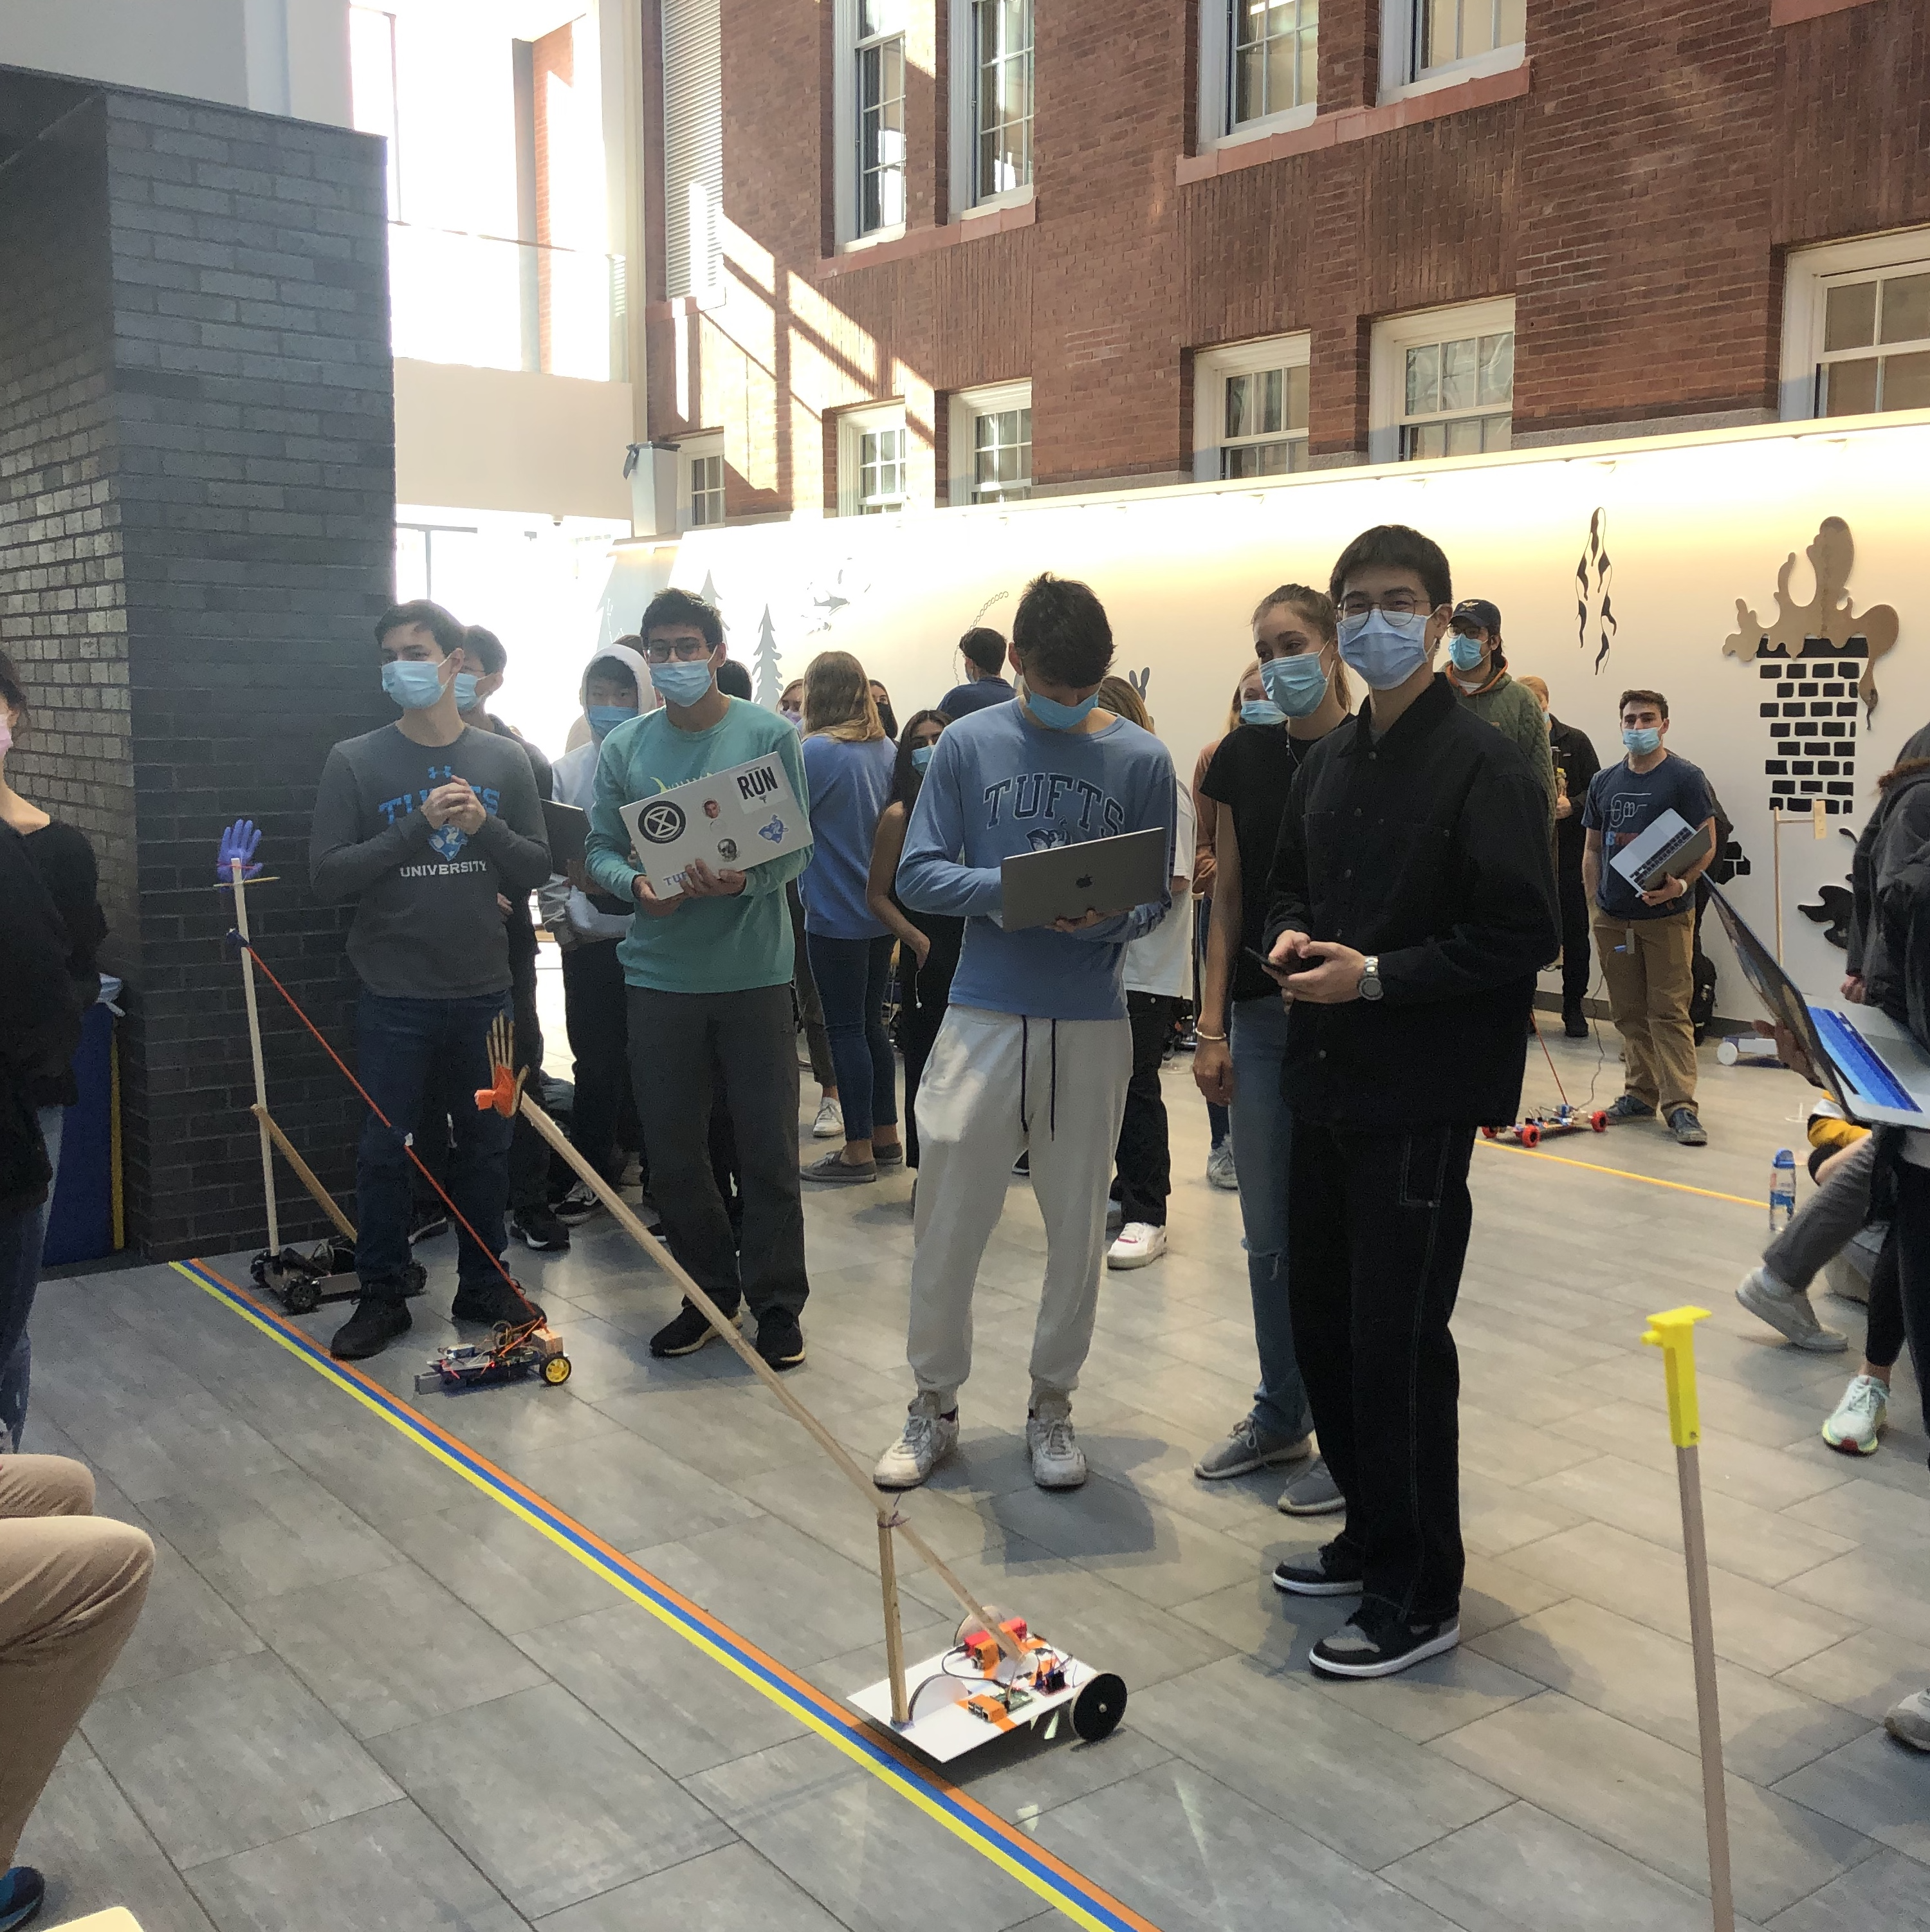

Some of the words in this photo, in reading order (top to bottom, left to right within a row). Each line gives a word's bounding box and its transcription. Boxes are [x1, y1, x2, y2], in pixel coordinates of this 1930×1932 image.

[737, 766, 778, 800] RUN
[983, 772, 1125, 837] TUFTS
[399, 860, 487, 878] UNIVERSITY
